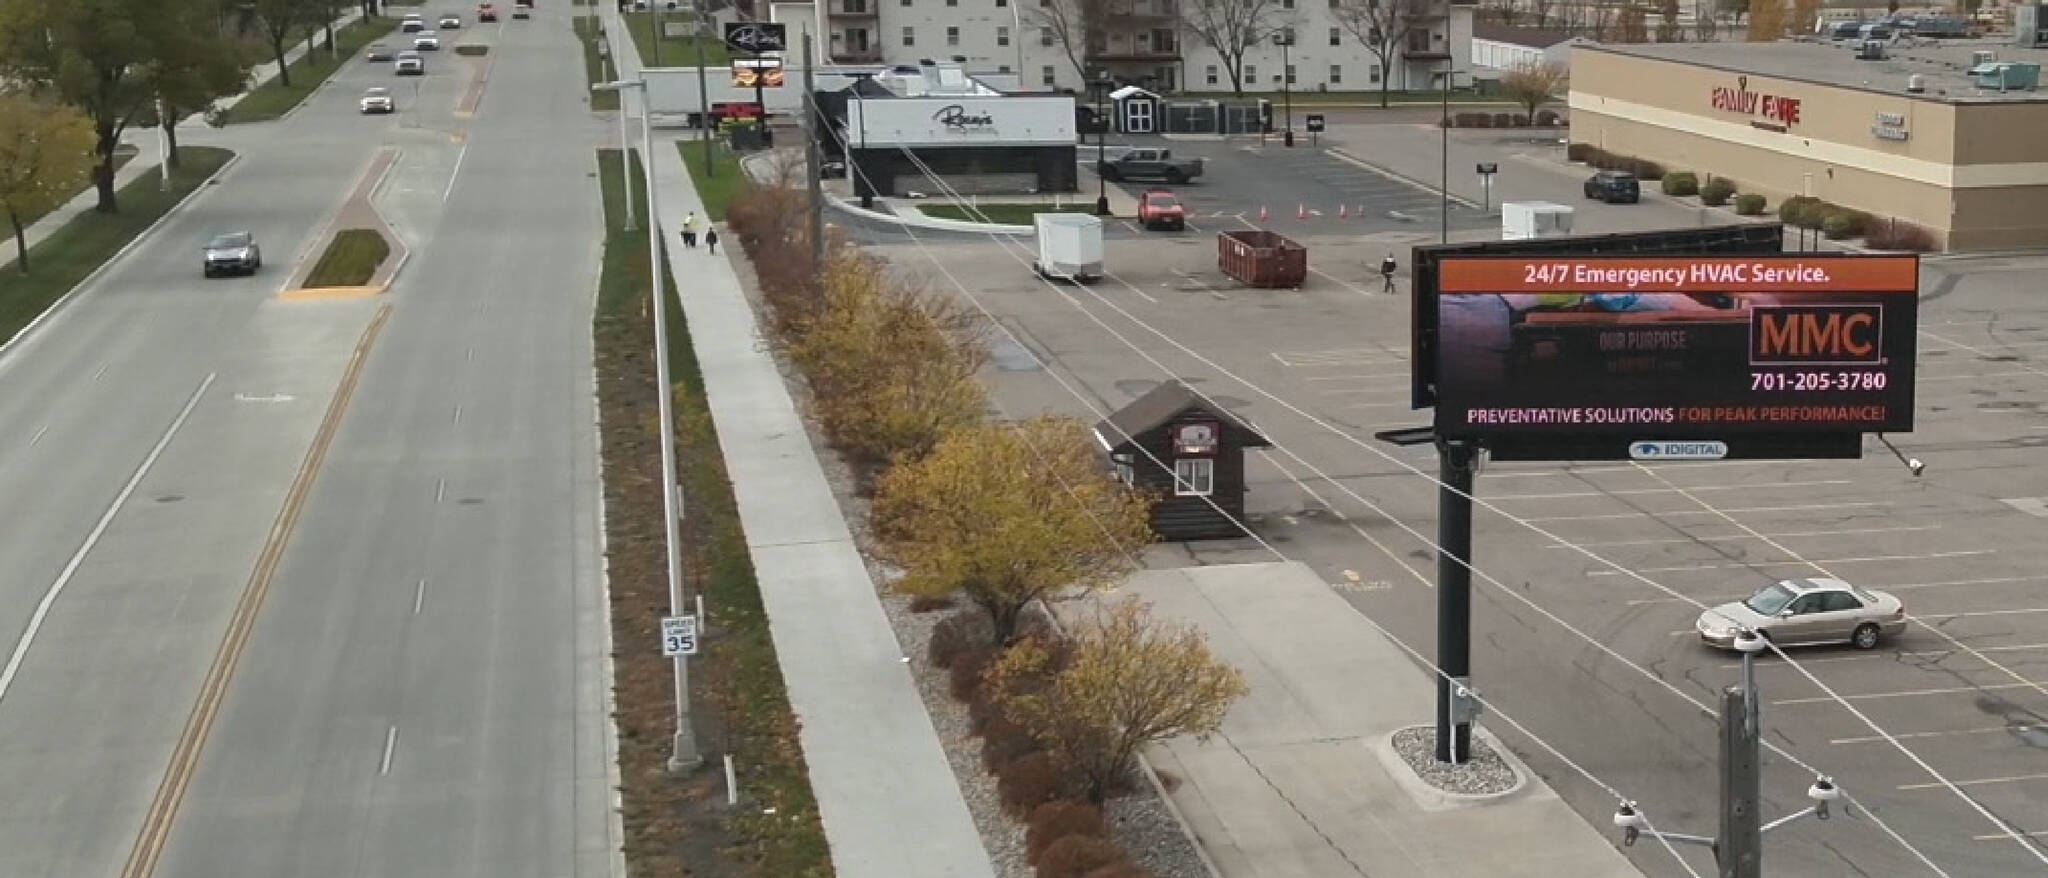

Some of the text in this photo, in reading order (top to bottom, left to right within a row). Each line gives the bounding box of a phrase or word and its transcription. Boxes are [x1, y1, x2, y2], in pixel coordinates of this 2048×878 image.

[1712, 87, 1758, 114] FAMILY
[1524, 263, 1831, 287] 24/7 Emergency HVAC Service.
[1760, 313, 1873, 356] MMC
[1751, 373, 1887, 391] 701-205-3780
[1467, 406, 1886, 424] PREVENTATIVE SOLUTIONS FOR PEAK PERFORMANCE!
[667, 636, 694, 652] 35
